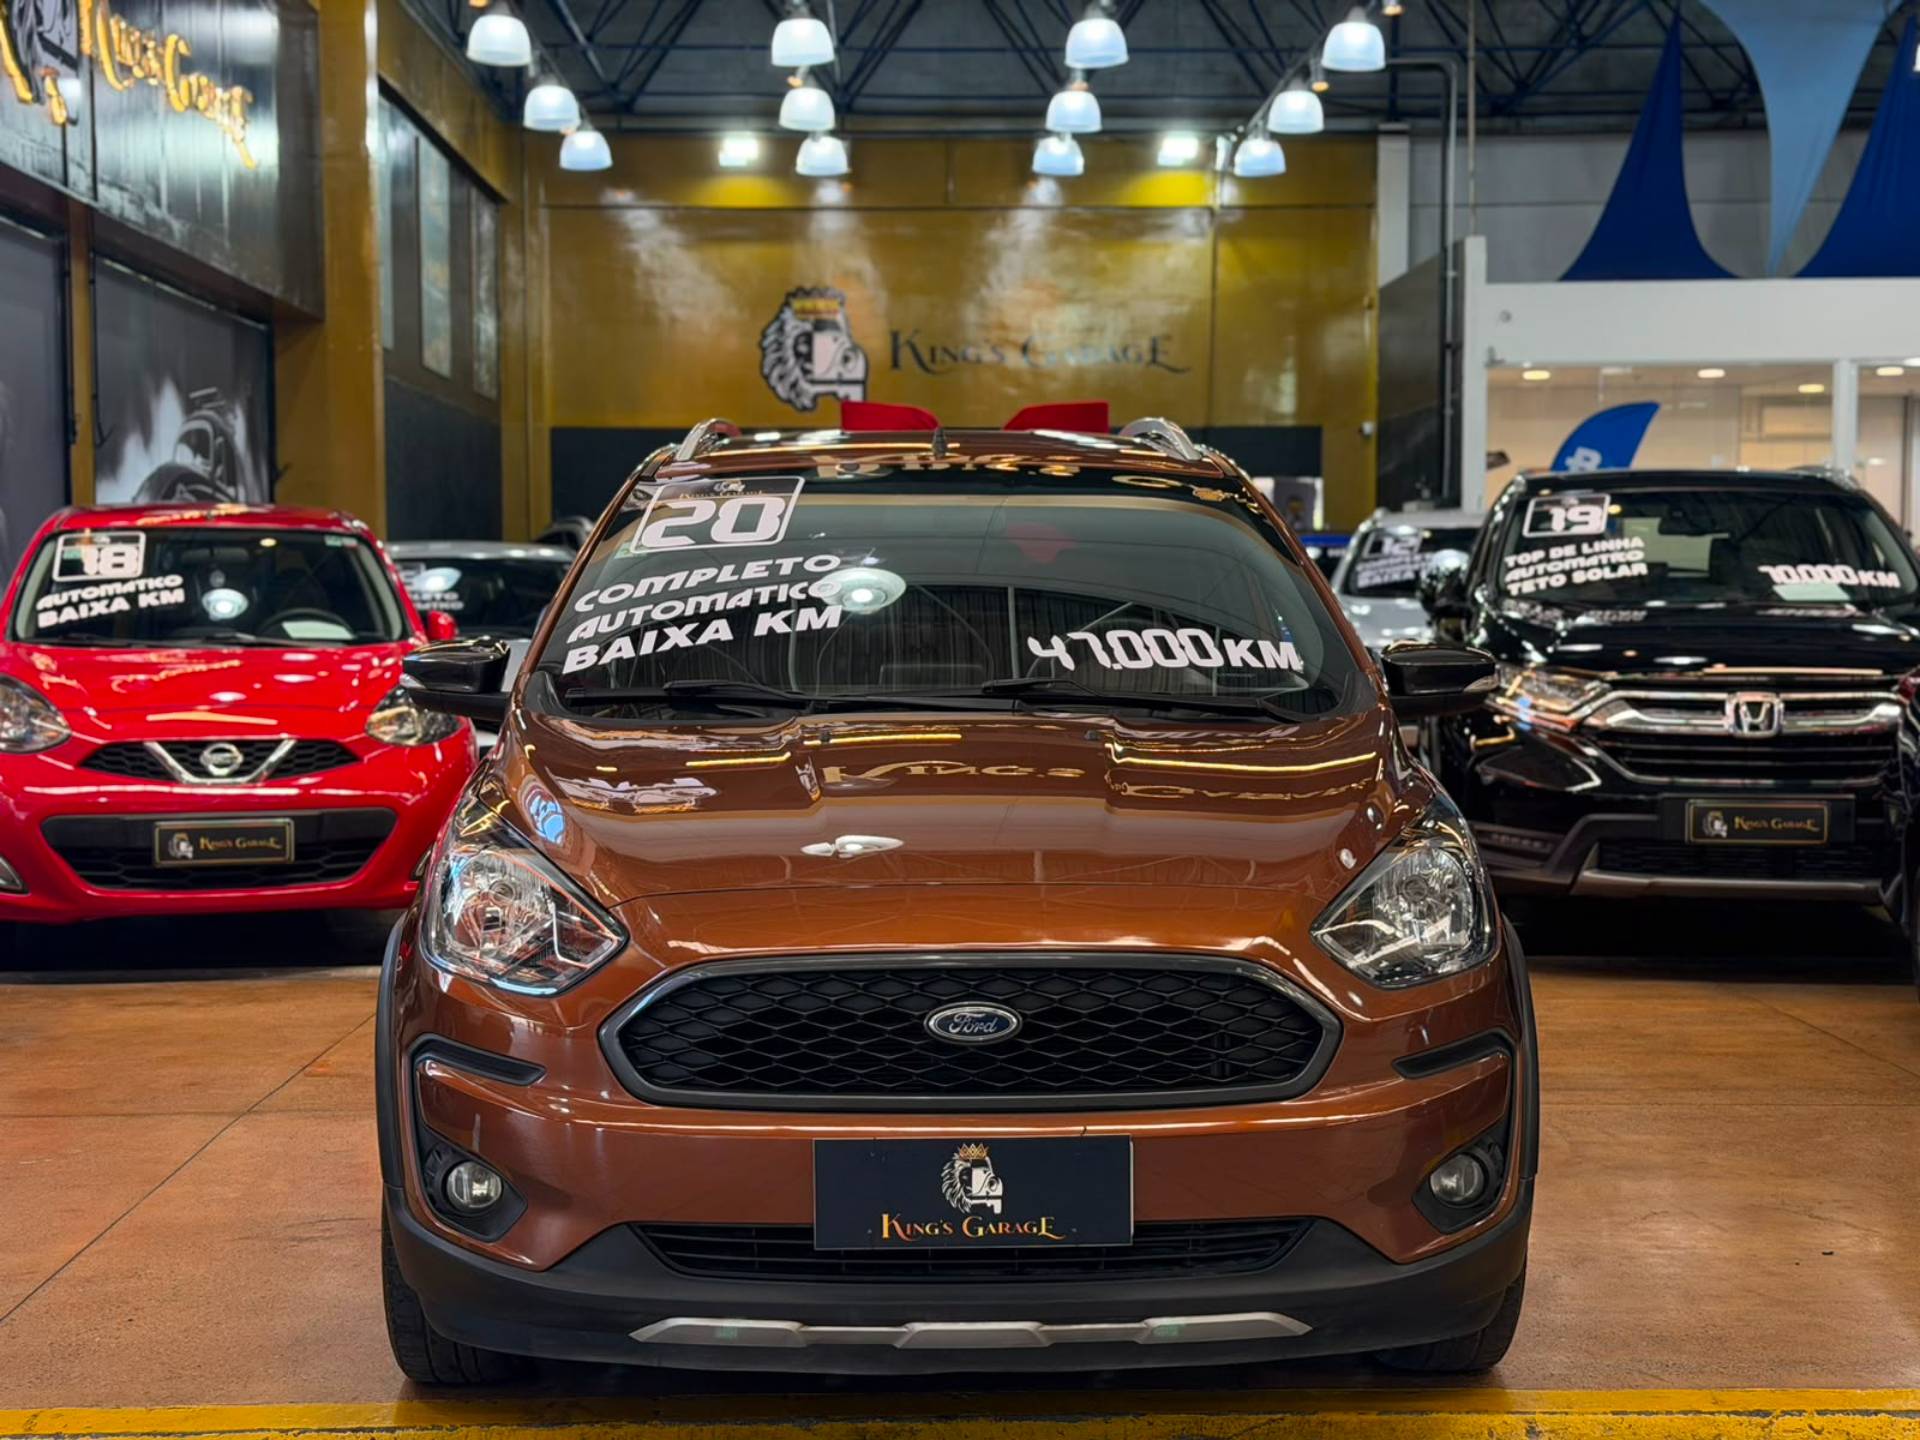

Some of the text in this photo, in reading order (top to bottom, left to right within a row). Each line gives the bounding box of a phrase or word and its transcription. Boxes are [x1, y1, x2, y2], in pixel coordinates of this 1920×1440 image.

[641, 497, 786, 549] 20
[1504, 536, 1645, 568] TOP DE LINHA
[574, 554, 841, 613] COMPLETO
[1507, 562, 1648, 596] TETO SOLAR
[38, 588, 186, 629] BAIXA KM
[566, 580, 842, 644] AUTOMATICO
[562, 605, 842, 675] BAIXA KM
[948, 1012, 999, 1033] Ford
[882, 1213, 1067, 1242] KING'S GARAGE
